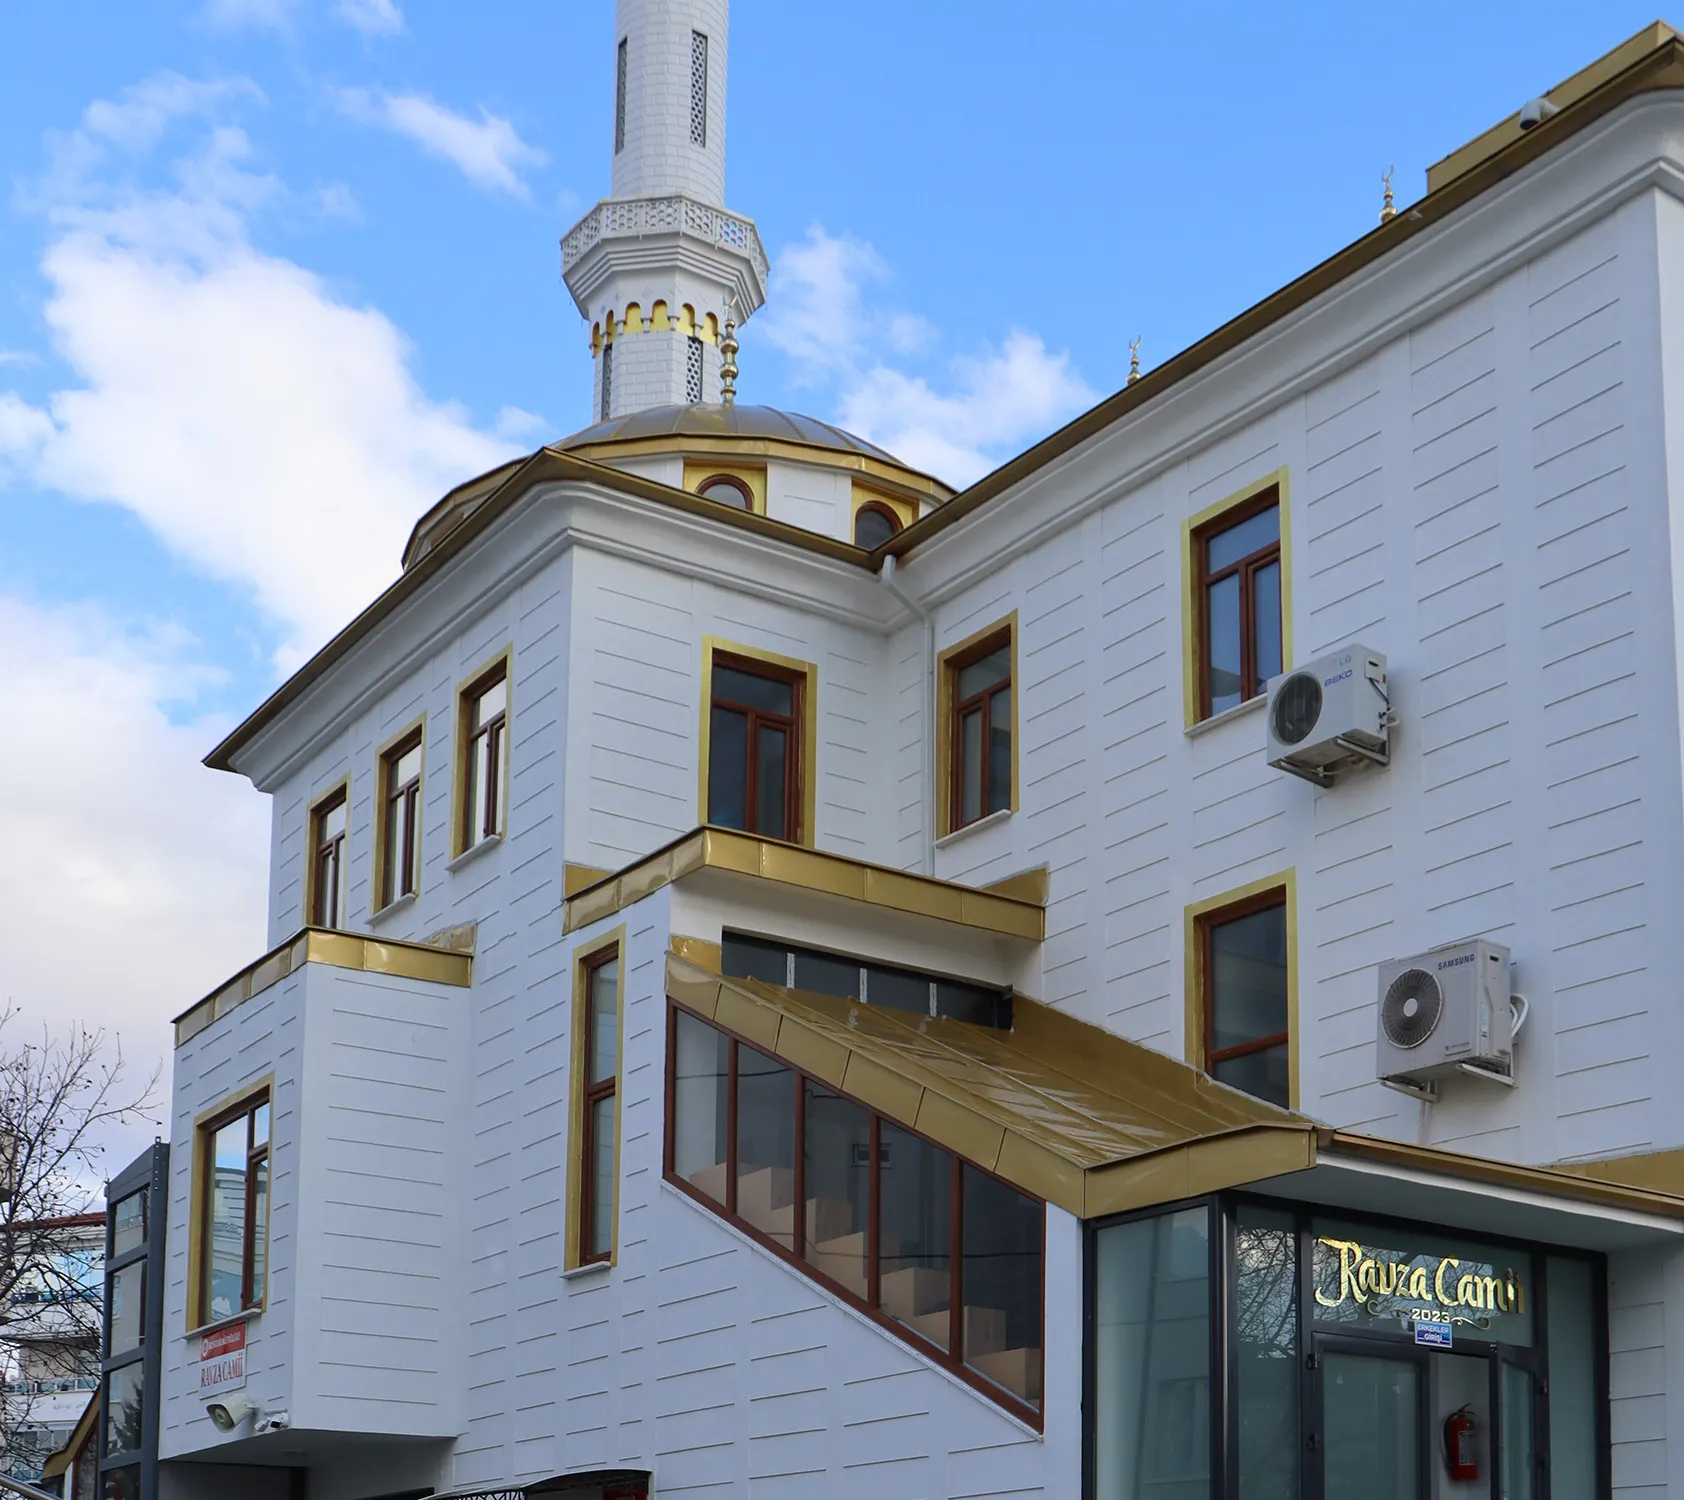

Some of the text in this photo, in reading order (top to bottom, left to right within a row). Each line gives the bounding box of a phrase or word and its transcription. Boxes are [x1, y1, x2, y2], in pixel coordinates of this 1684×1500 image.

[1324, 669, 1353, 687] BEKO
[1438, 953, 1475, 970] SAMSUNG
[1314, 1235, 1524, 1314] Ravza Camii
[1411, 1308, 1450, 1323] 2023
[1417, 1323, 1449, 1333] ERKEKLER
[201, 1363, 222, 1388] RAVZA
